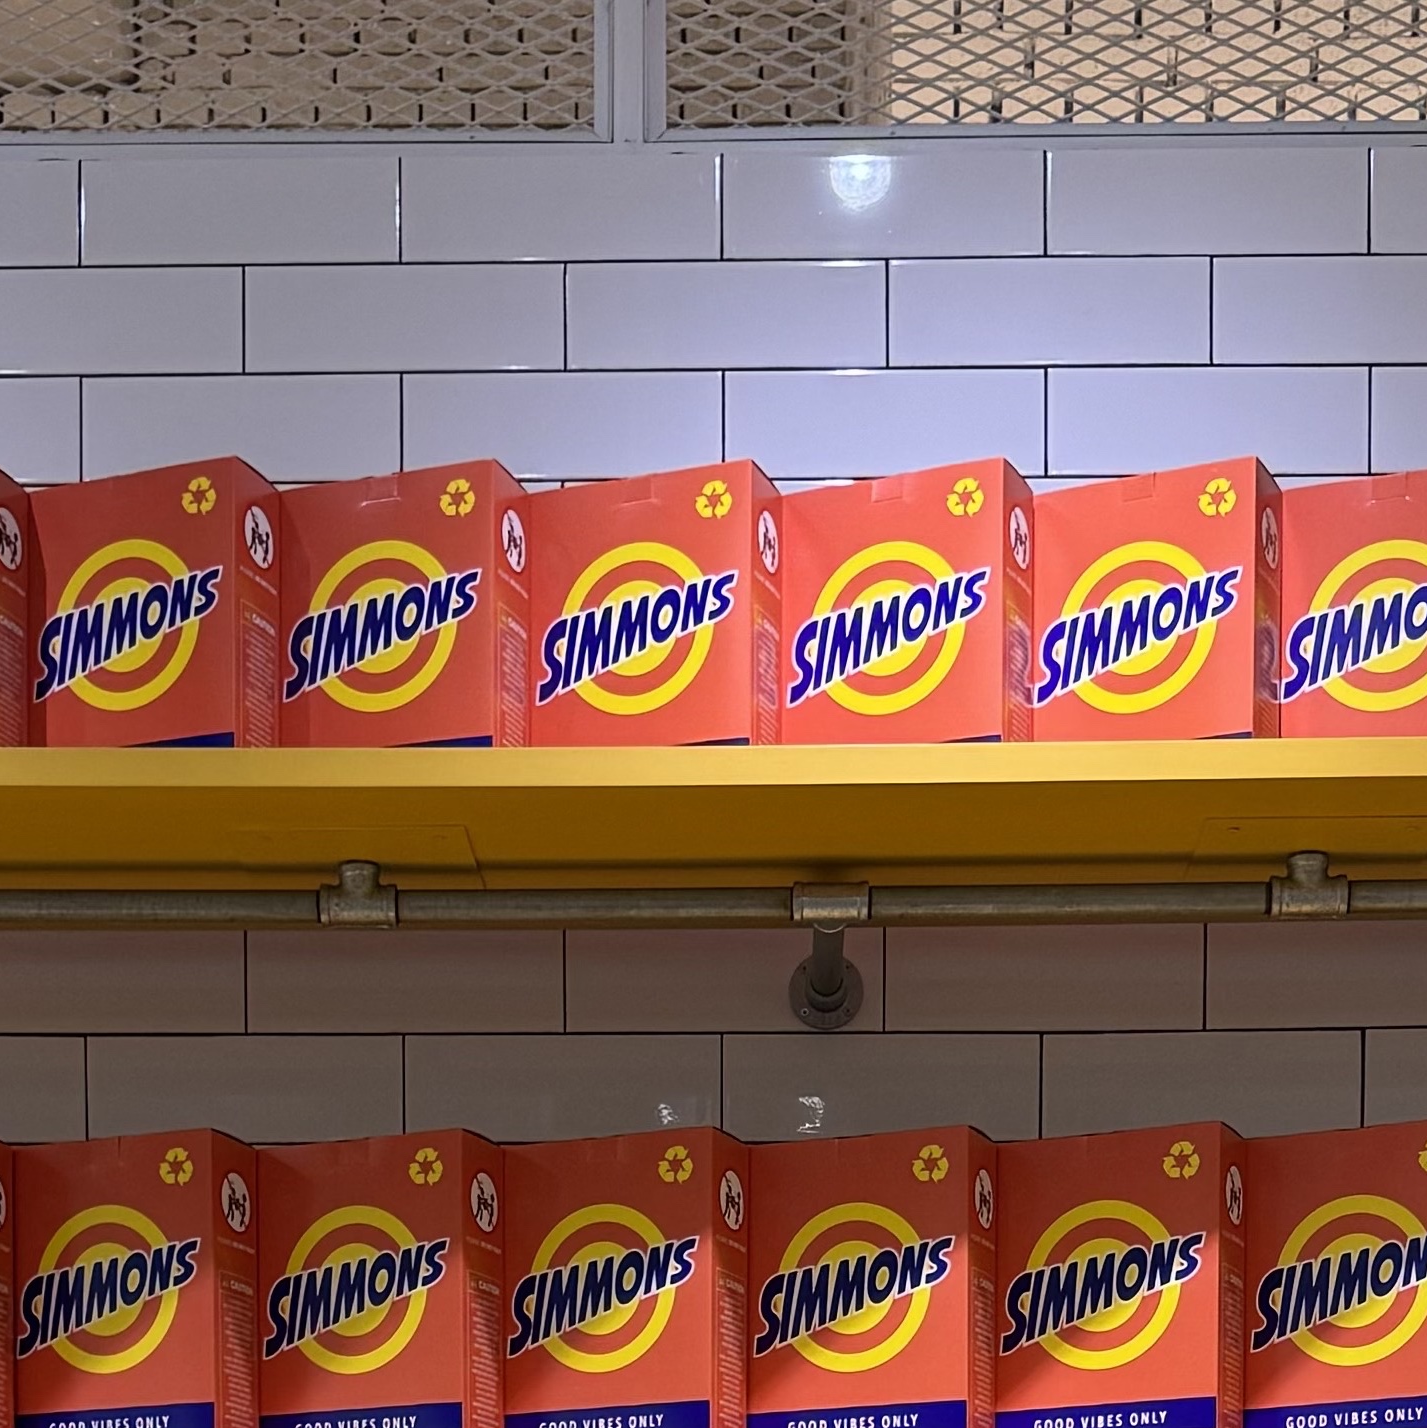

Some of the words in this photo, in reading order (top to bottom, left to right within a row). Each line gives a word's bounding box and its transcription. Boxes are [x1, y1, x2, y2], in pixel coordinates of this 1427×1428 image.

[34, 566, 223, 701] SIMMONS
[283, 569, 482, 701] SIMMONS
[536, 571, 738, 705] SIMMONS
[787, 569, 990, 706] SIMMONS
[1034, 567, 1242, 705] SIMMONS
[18, 1239, 200, 1356] SIMMONS
[264, 1239, 449, 1357] SIMMONS
[508, 1236, 699, 1356] SIMMONS
[755, 1236, 954, 1354] SIMMONS
[1001, 1233, 1205, 1353] SIMMONS
[881, 1413, 919, 1428] ONLY
[1129, 1410, 1168, 1427] ONLY
[1334, 1410, 1378, 1426] VIBES
[1384, 1406, 1424, 1423] ONLY
